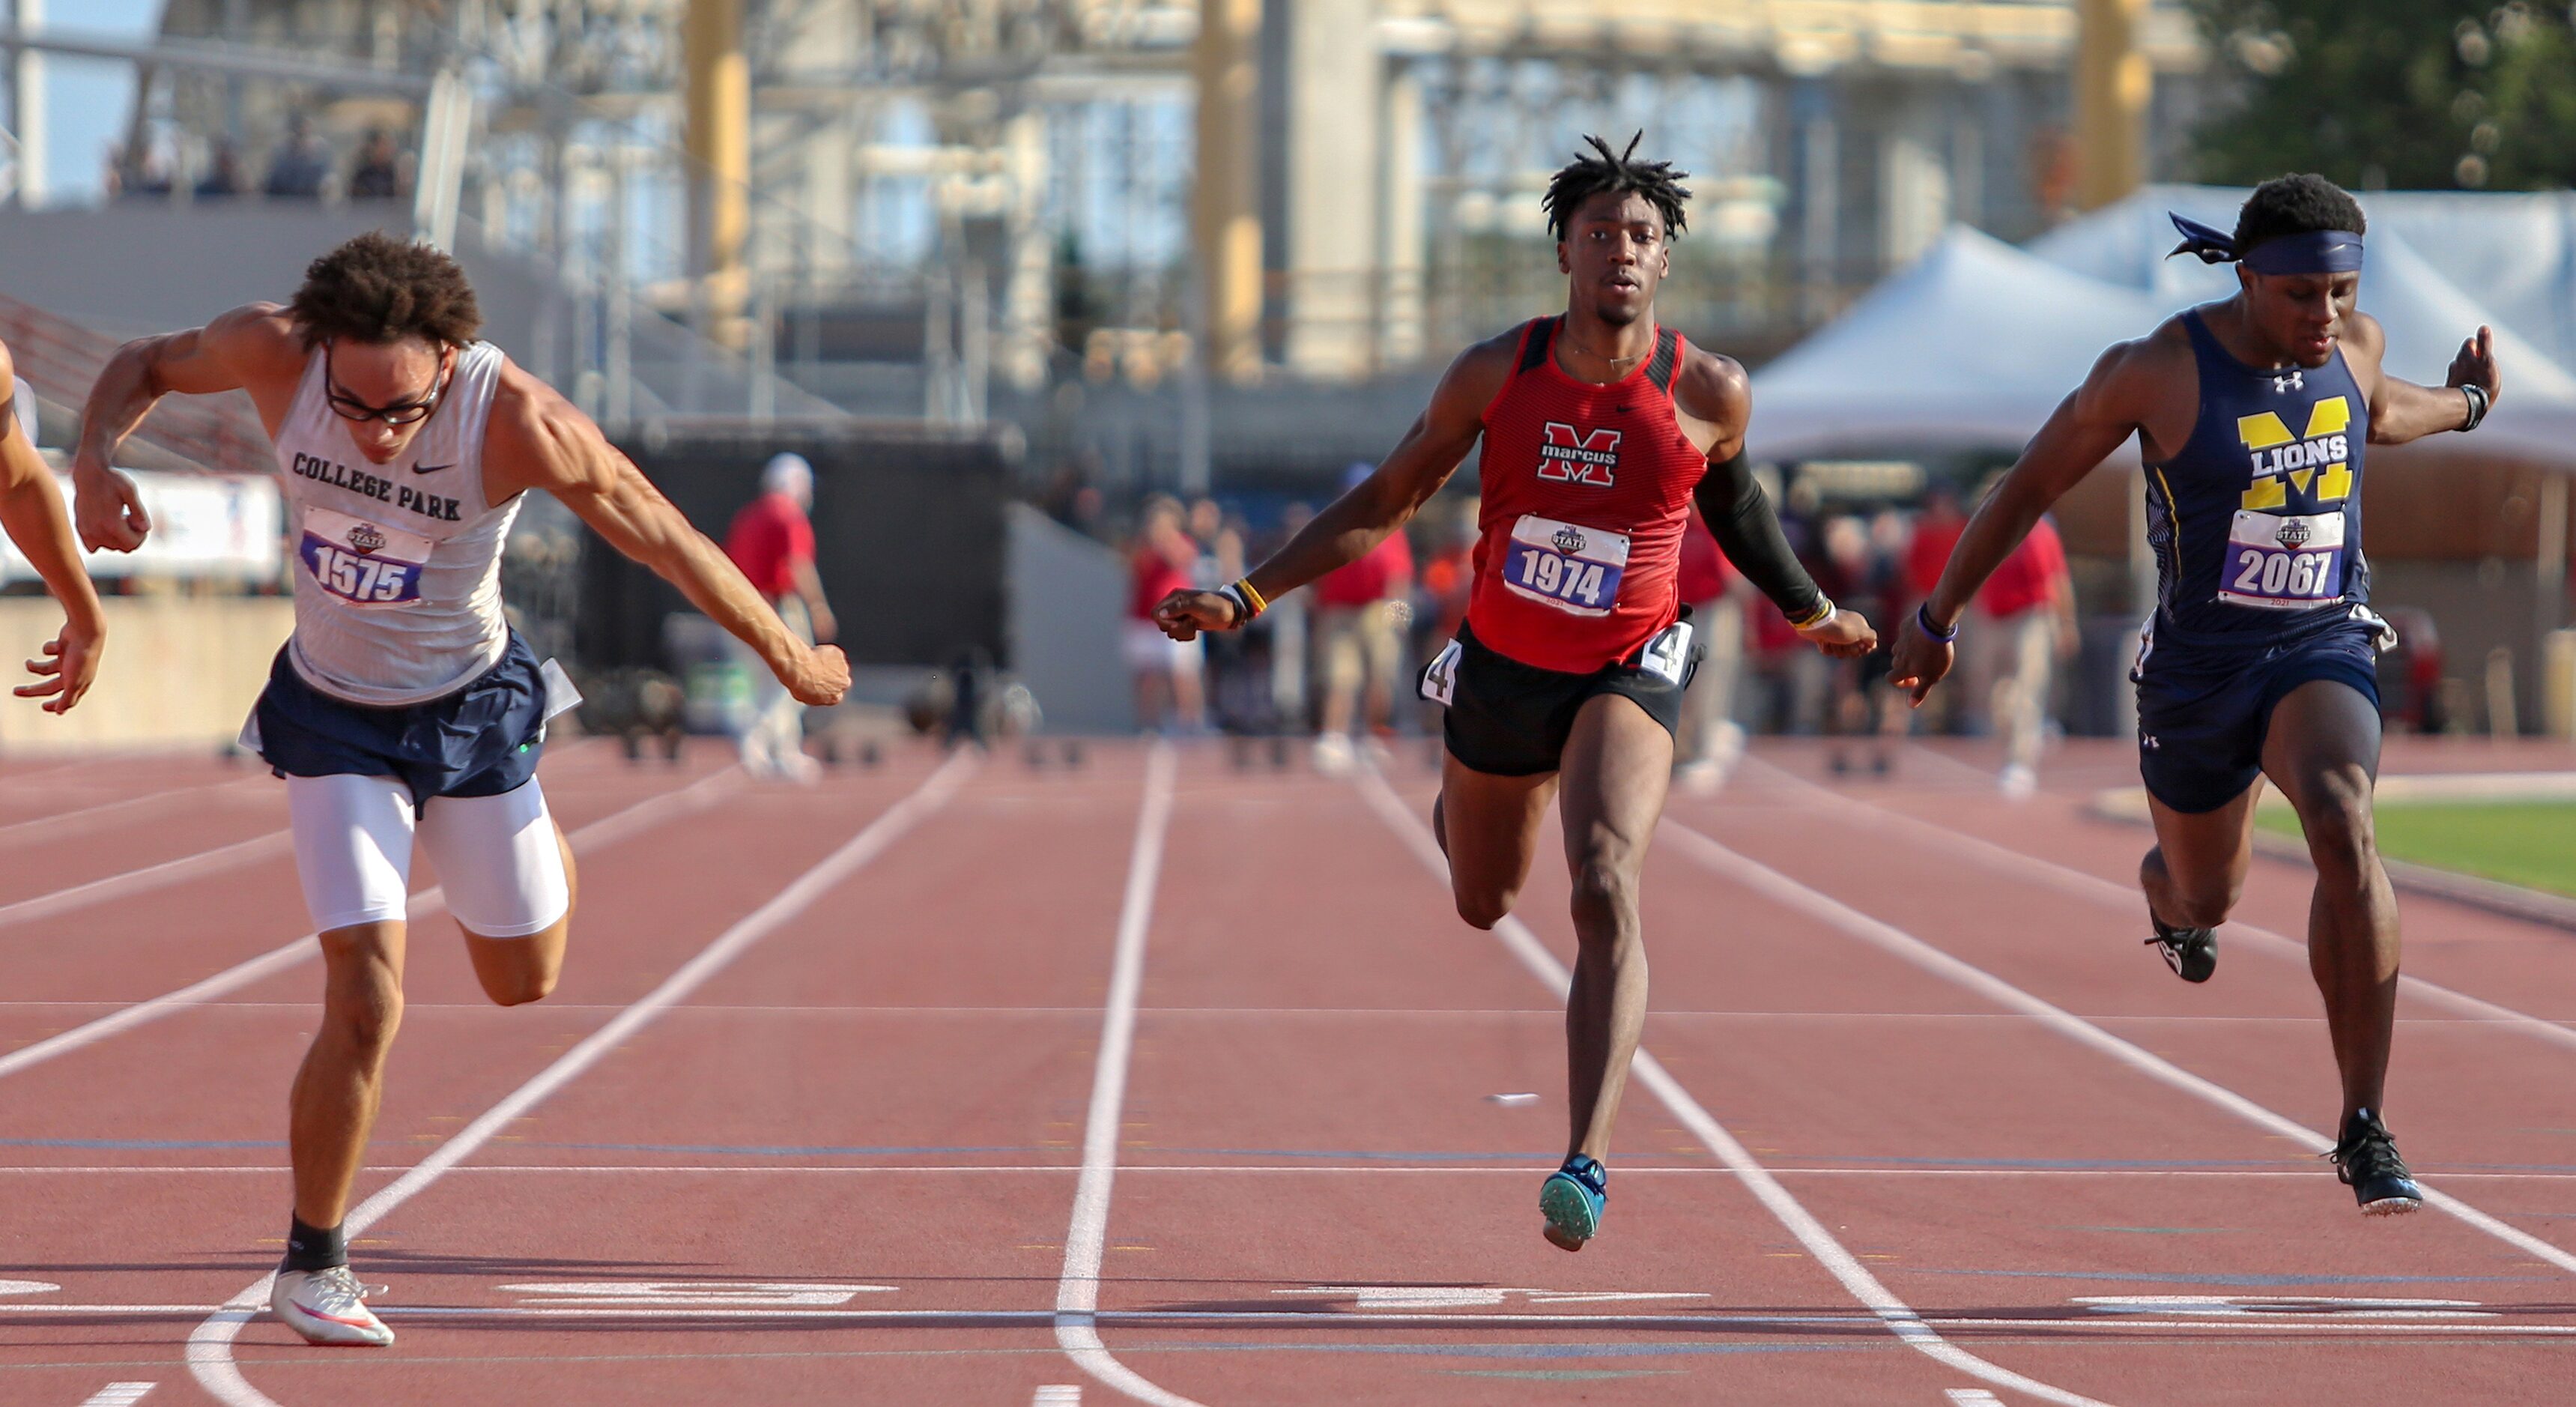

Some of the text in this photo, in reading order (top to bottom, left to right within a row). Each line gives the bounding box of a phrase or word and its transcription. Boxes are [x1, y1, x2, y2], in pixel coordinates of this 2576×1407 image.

[1536, 421, 1622, 488] M
[1541, 444, 1618, 466] marcus
[2237, 395, 2352, 510] M
[2249, 435, 2349, 477] LIONS
[292, 452, 462, 521] COLLEGE PARK
[1551, 533, 1586, 550] STATE
[2276, 530, 2310, 540] STATE
[313, 545, 408, 601] 1575
[1521, 548, 1605, 605] 1974
[2233, 549, 2333, 595] 2067
[1428, 647, 1458, 698] 4
[1649, 624, 1681, 673] 4
